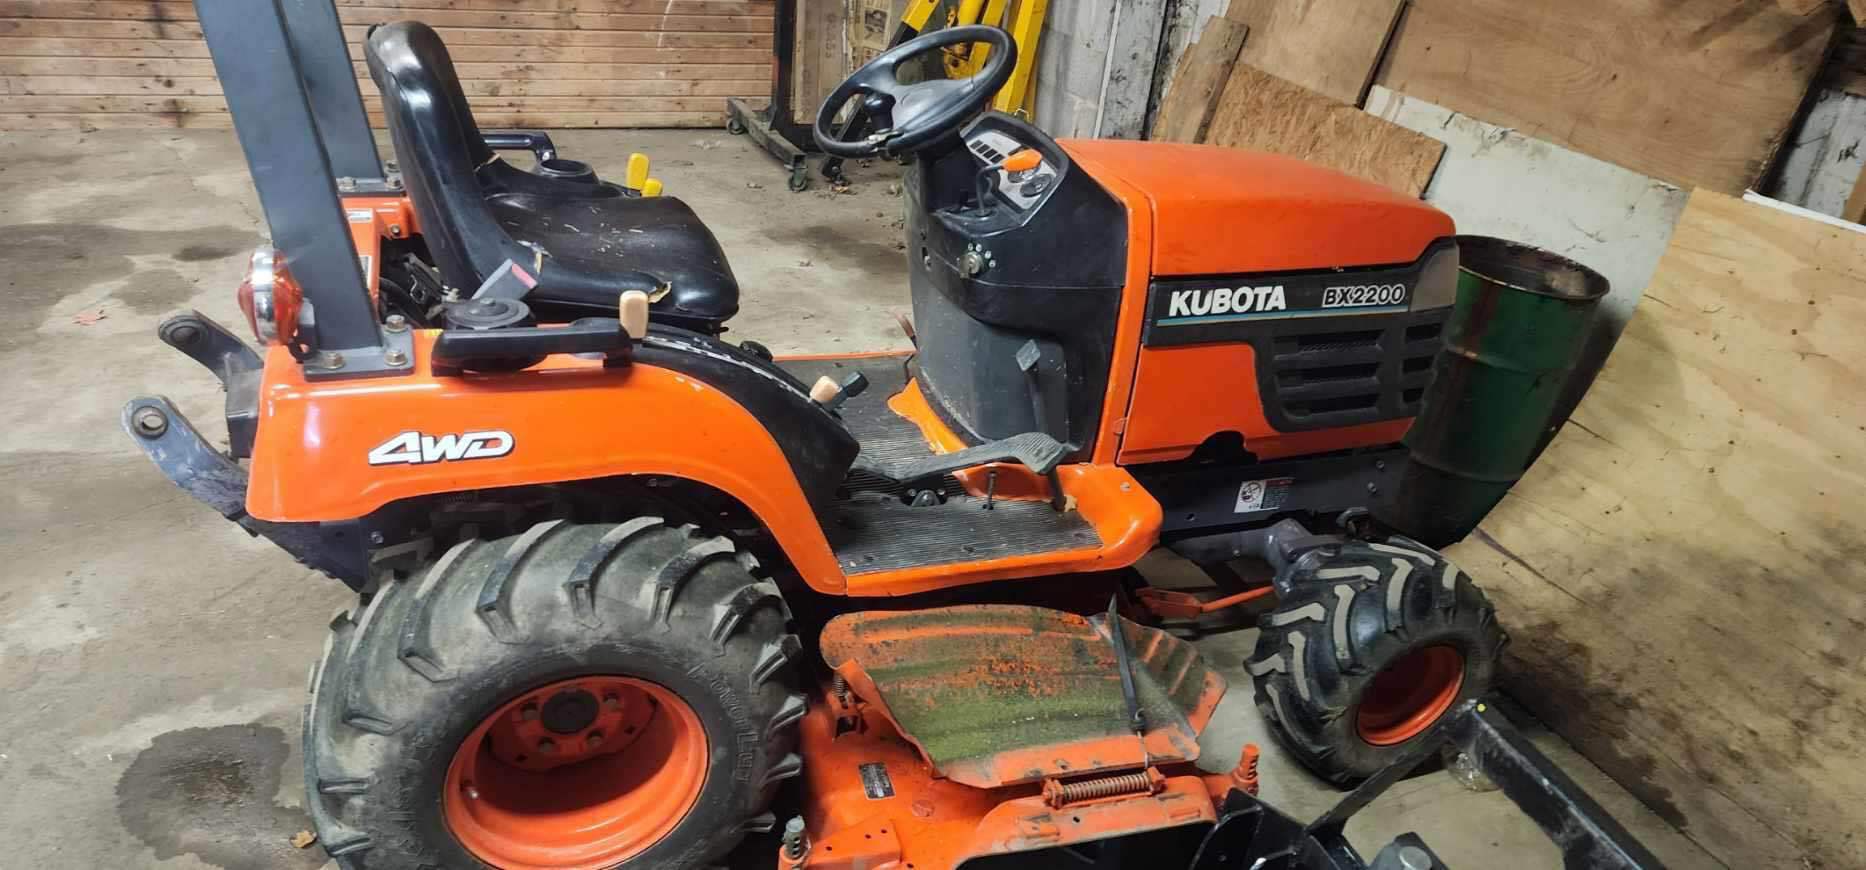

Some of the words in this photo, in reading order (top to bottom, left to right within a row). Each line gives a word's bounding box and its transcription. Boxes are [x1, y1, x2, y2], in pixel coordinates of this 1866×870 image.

[1169, 286, 1287, 316] KUBOTA
[1321, 284, 1406, 308] BX2200
[368, 430, 515, 466] 4WD
